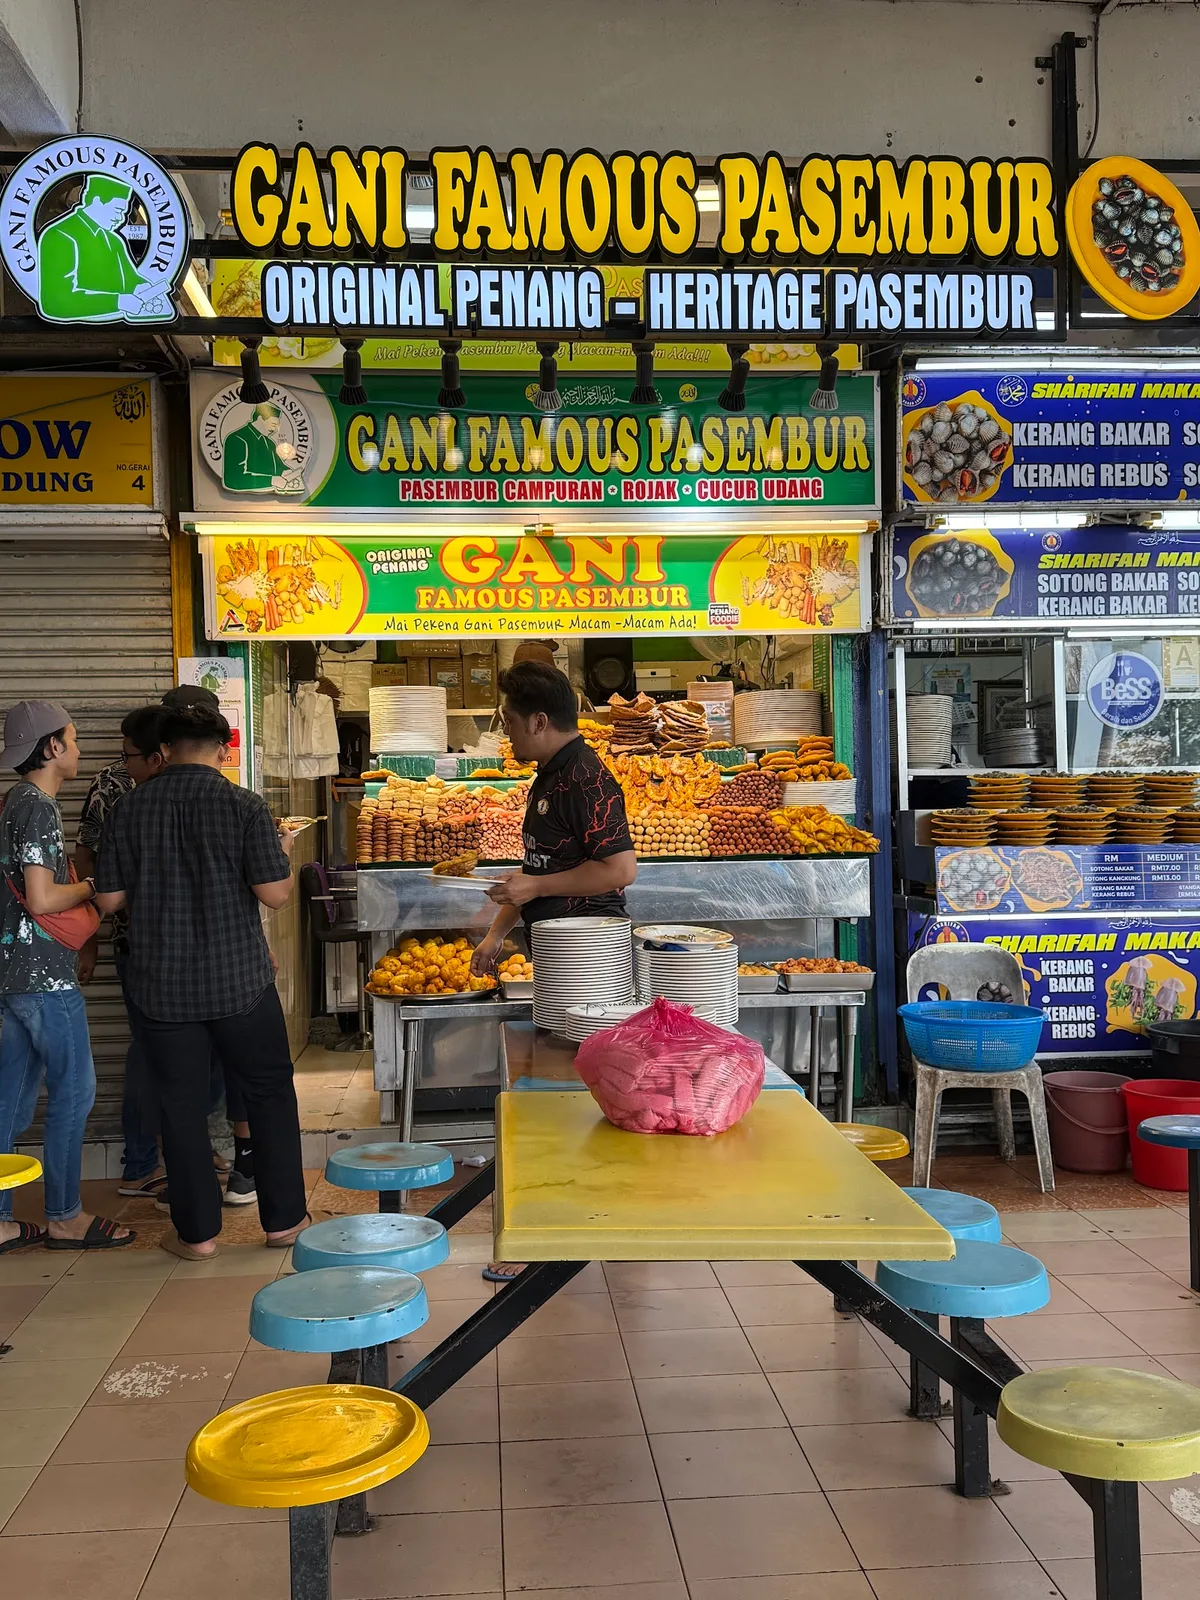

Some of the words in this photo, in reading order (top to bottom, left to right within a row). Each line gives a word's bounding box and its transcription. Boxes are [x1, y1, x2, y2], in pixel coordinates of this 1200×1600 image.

[14, 147, 105, 207] FAMOUS
[235, 146, 406, 250] GANI
[432, 149, 698, 256] FAMOUS
[719, 154, 1060, 257] PASEMBUR
[112, 152, 176, 273] PASEMBUR
[9, 209, 36, 273] GANI
[265, 266, 444, 326] ORIGINAL
[455, 268, 602, 328] PENANG
[650, 272, 822, 330] HERITAGE
[834, 272, 1034, 330] PASEMBUR
[375, 346, 400, 360] Mai
[403, 344, 446, 358] Peken
[461, 342, 516, 356] asembur
[1031, 383, 1135, 399] SHARIFAH
[205, 422, 222, 461] GANI
[270, 388, 309, 464] PASEMBUR
[1013, 422, 1095, 446] KERANG
[1100, 422, 1170, 446] BAKAR
[1183, 422, 1200, 446] S
[347, 414, 457, 473] GANI
[467, 415, 639, 474] FAMOUS
[648, 415, 871, 473] PASEMBUR
[1, 472, 94, 493] DUNG
[131, 474, 146, 491] 4
[1013, 463, 1095, 487] KERANG
[1100, 463, 1168, 487] REBUS
[1183, 462, 1200, 486] S
[401, 480, 498, 500] PASEMBUR
[504, 480, 603, 500] CAMPURAN
[623, 480, 677, 500] ROJAK
[697, 480, 758, 500] CUCUR
[763, 479, 823, 499] UDANG
[365, 547, 433, 563] ORIGINAL
[440, 536, 666, 585] GANI
[1037, 552, 1151, 568] SHARIFAH
[372, 560, 429, 575] PENANG
[1037, 573, 1107, 593] SOTONG
[1111, 572, 1169, 592] BAKAR
[417, 587, 534, 610] FAMOUS
[539, 586, 689, 609] PASEMBUR
[1037, 596, 1105, 616] KERANG
[1109, 595, 1167, 615] BAKAR
[384, 616, 409, 631] Mai
[464, 618, 493, 631] Gani
[568, 615, 611, 629] Macam
[669, 614, 697, 629] Ada!
[1101, 677, 1152, 700] BeSS
[1104, 854, 1119, 862] RM
[1147, 853, 1184, 862] MEDIUM
[1151, 864, 1181, 872] RM17.00
[1041, 959, 1094, 976] KERANG
[1049, 977, 1095, 993] BAKAR
[1043, 1005, 1096, 1022] KERANG
[1052, 1023, 1096, 1039] REBUS
